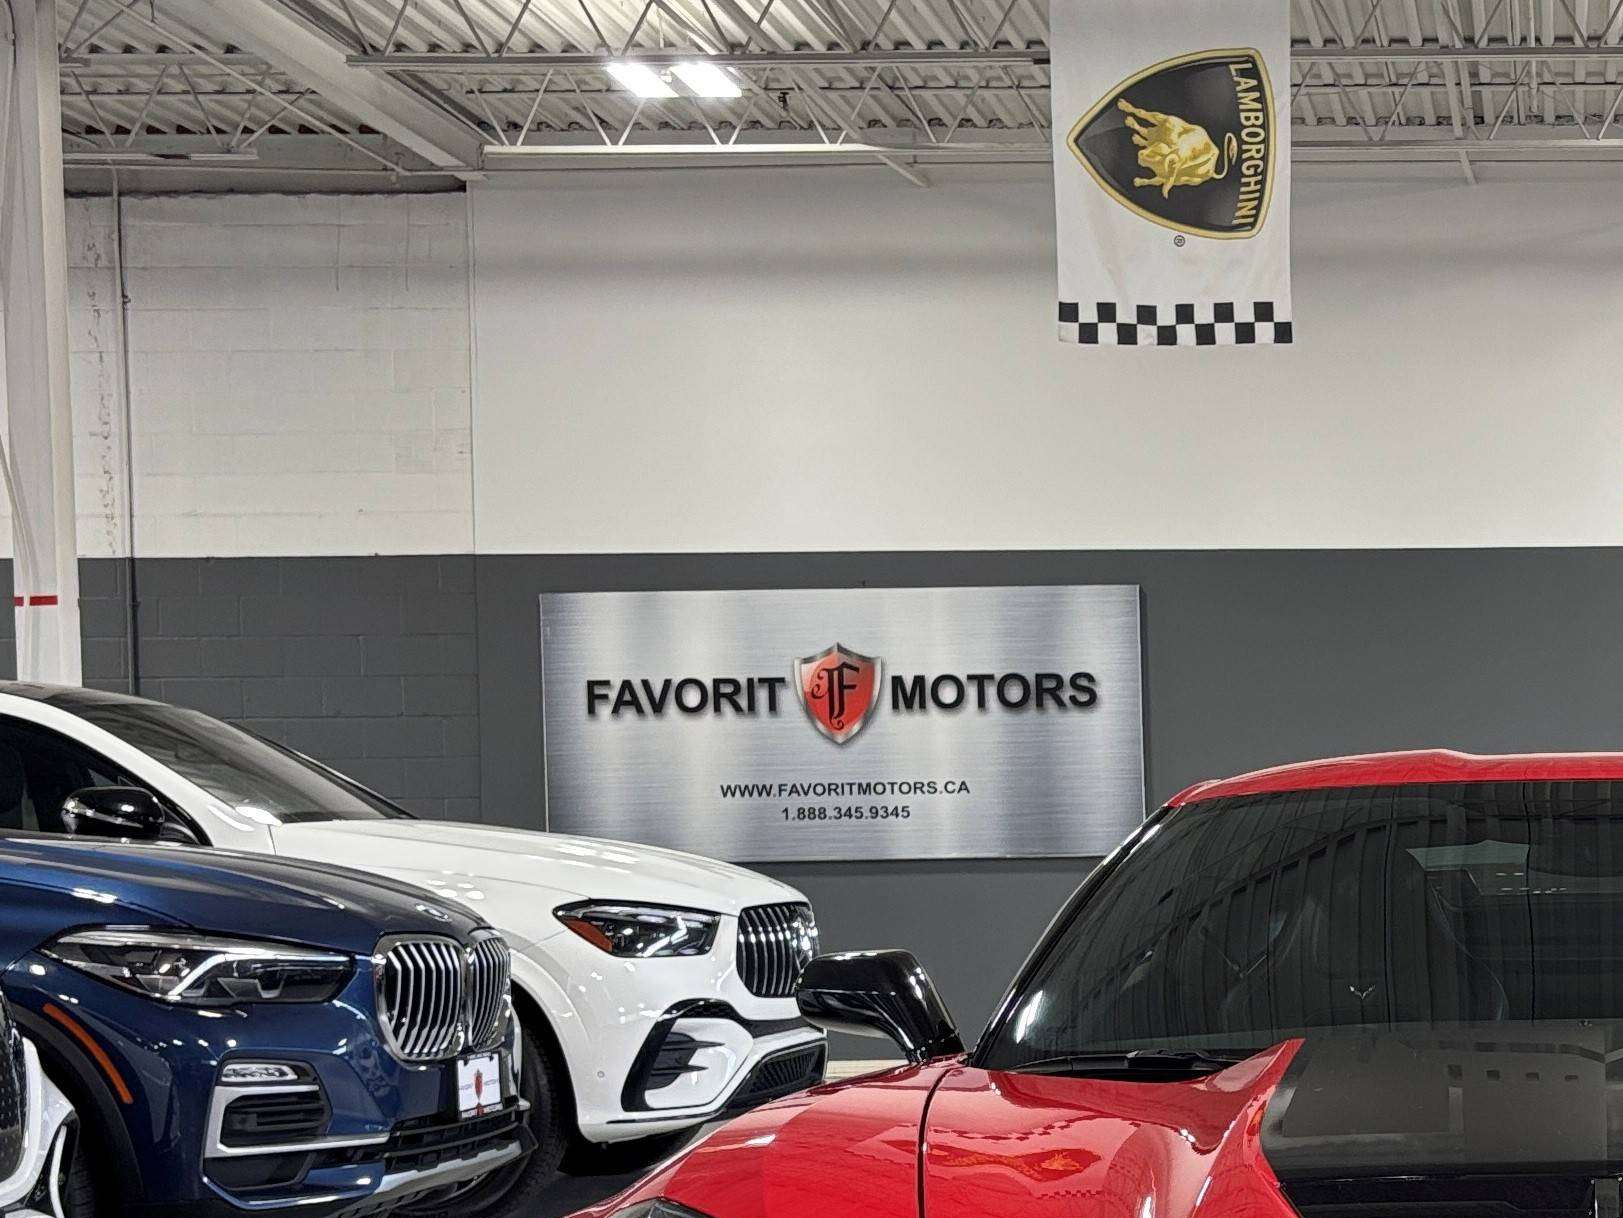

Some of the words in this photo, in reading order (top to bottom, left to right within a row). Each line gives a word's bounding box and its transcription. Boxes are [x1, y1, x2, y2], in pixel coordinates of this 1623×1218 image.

[1229, 62, 1265, 225] LAMBORGHINI
[586, 677, 787, 717] FAVORIT
[891, 671, 1098, 711] MOTORS
[720, 779, 970, 799] WWW.FAVORITMOTORS.CA
[781, 805, 911, 822] 1.888.345.9345
